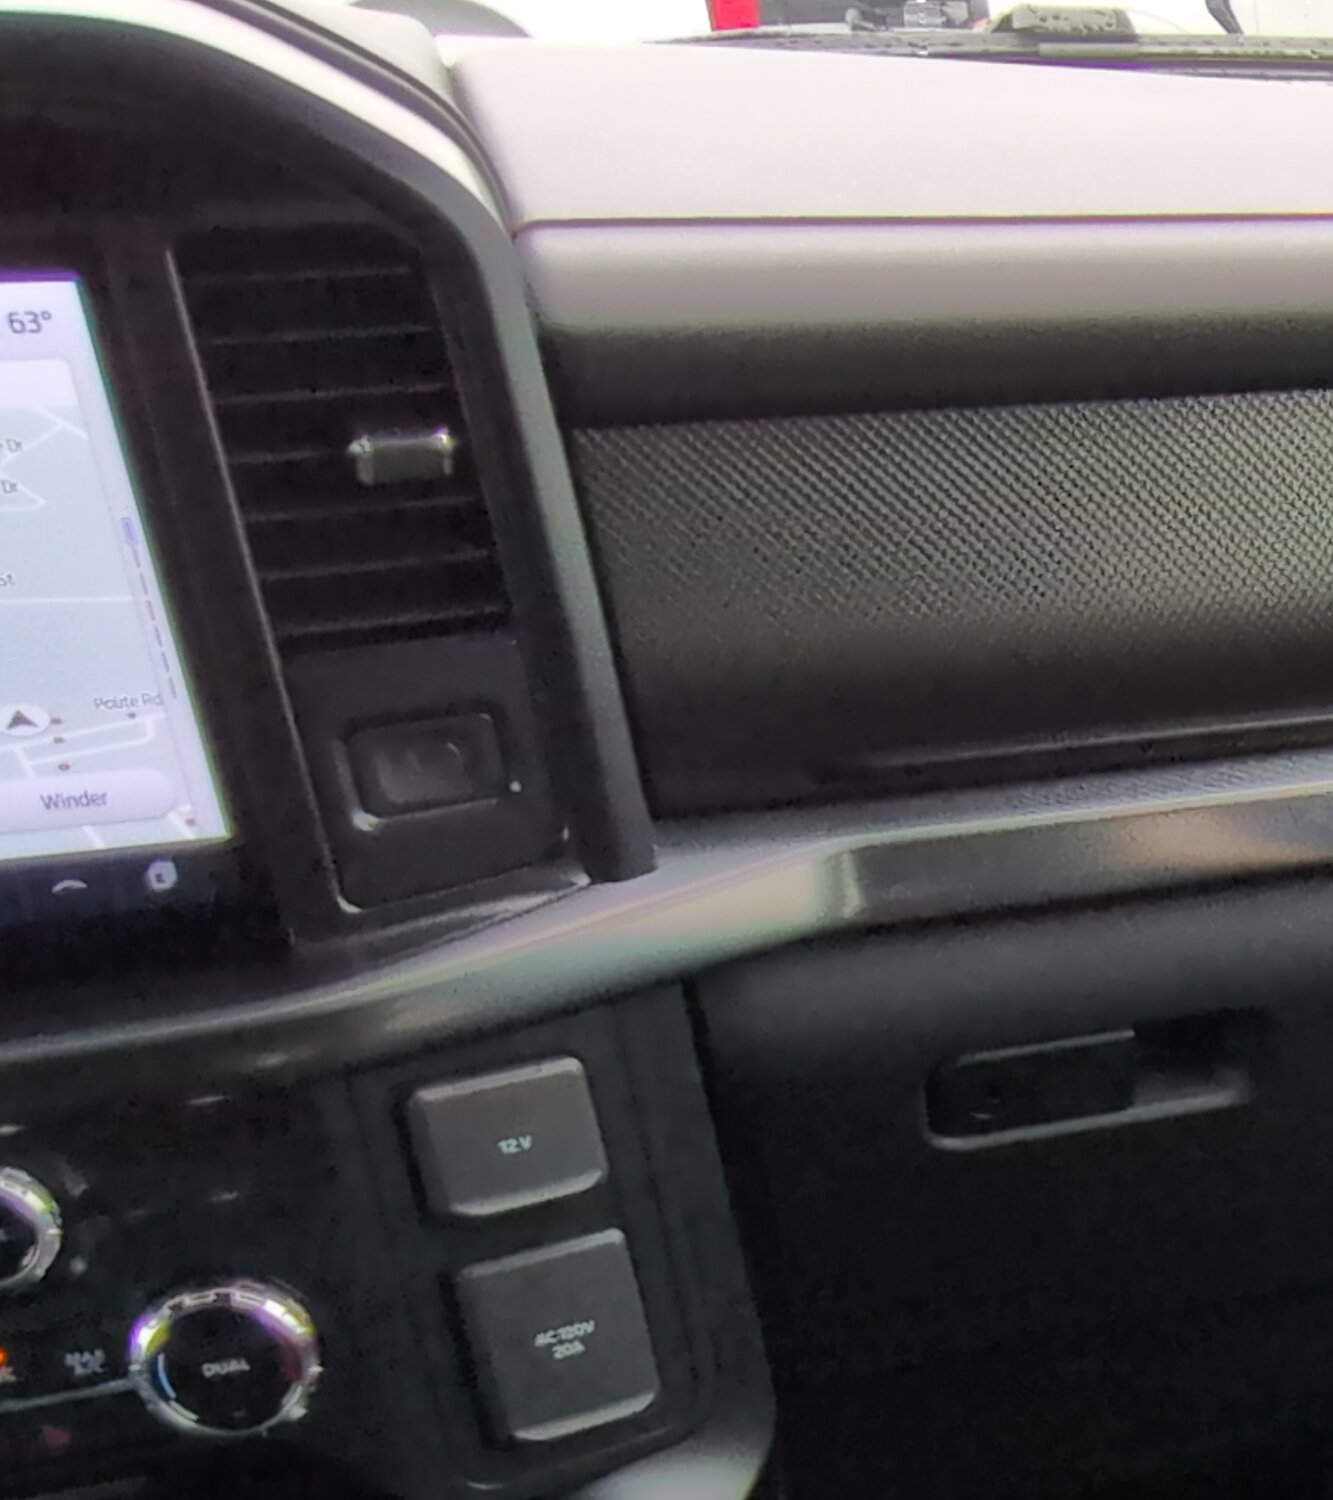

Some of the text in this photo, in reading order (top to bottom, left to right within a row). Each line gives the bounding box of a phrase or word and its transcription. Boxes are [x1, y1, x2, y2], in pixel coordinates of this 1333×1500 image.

[7, 310, 53, 335] 63°
[40, 789, 109, 812] Winder
[201, 1357, 251, 1379] DUAL
